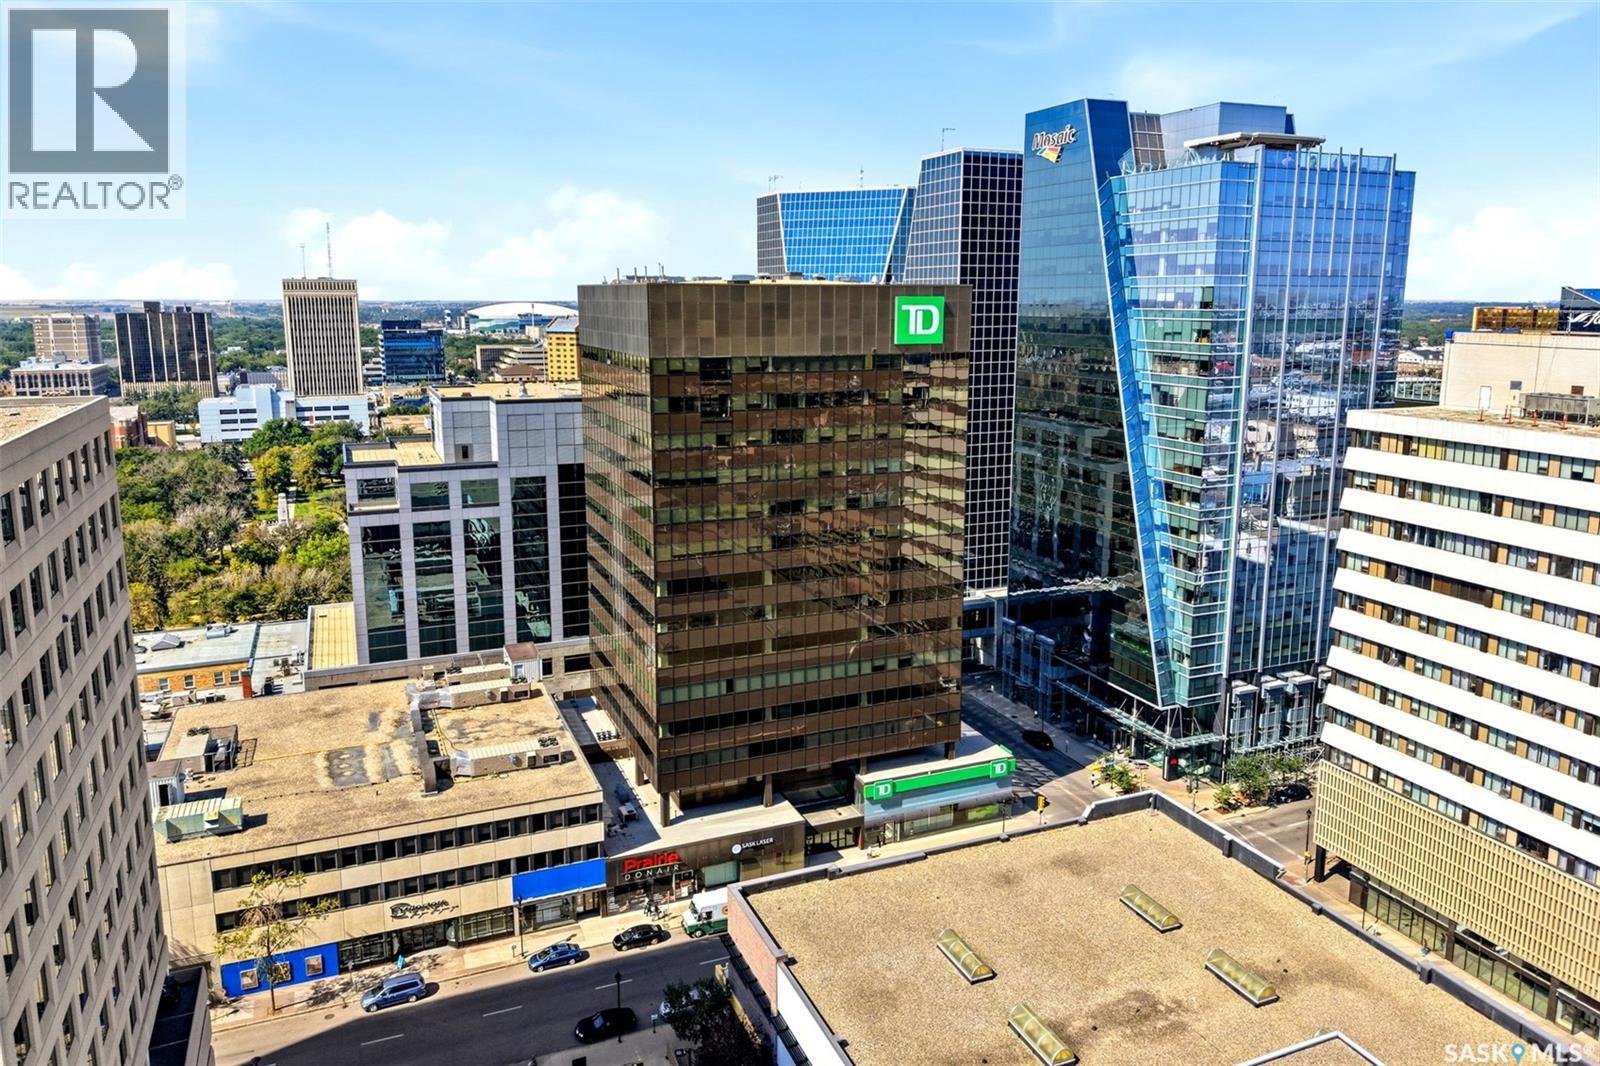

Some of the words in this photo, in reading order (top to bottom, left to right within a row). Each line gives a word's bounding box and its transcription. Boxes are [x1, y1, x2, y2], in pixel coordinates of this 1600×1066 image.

[1032, 123, 1078, 151] Mosaic
[901, 304, 940, 336] TD
[993, 762, 1007, 775] TD
[877, 783, 892, 796] TD
[741, 841, 756, 849] SASK
[756, 837, 774, 846] LASER
[623, 850, 680, 873] Prairie
[624, 864, 679, 881] DONAIR
